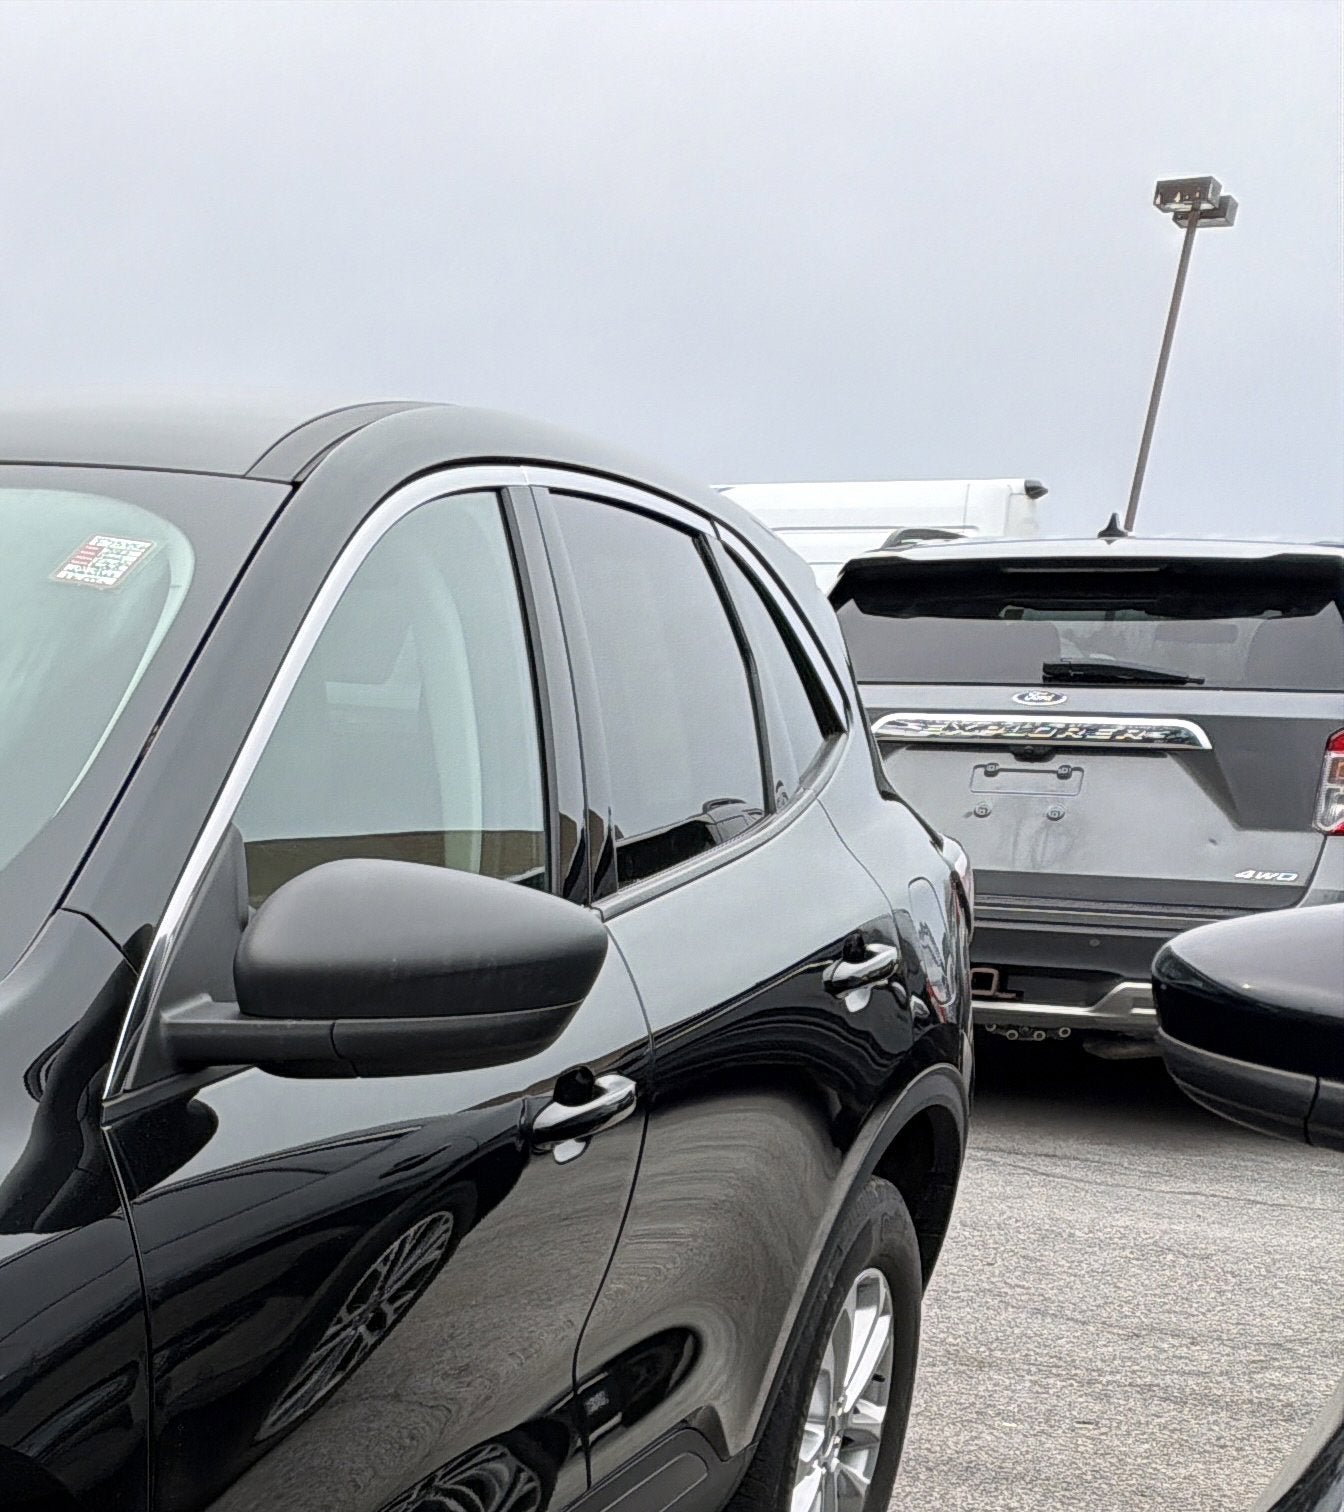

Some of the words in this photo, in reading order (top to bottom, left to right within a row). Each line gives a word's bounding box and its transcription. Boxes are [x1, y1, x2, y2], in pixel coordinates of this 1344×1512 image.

[1023, 690, 1055, 703] Ford
[919, 720, 1147, 740] EXPLORER
[1234, 869, 1299, 882] 4WD
